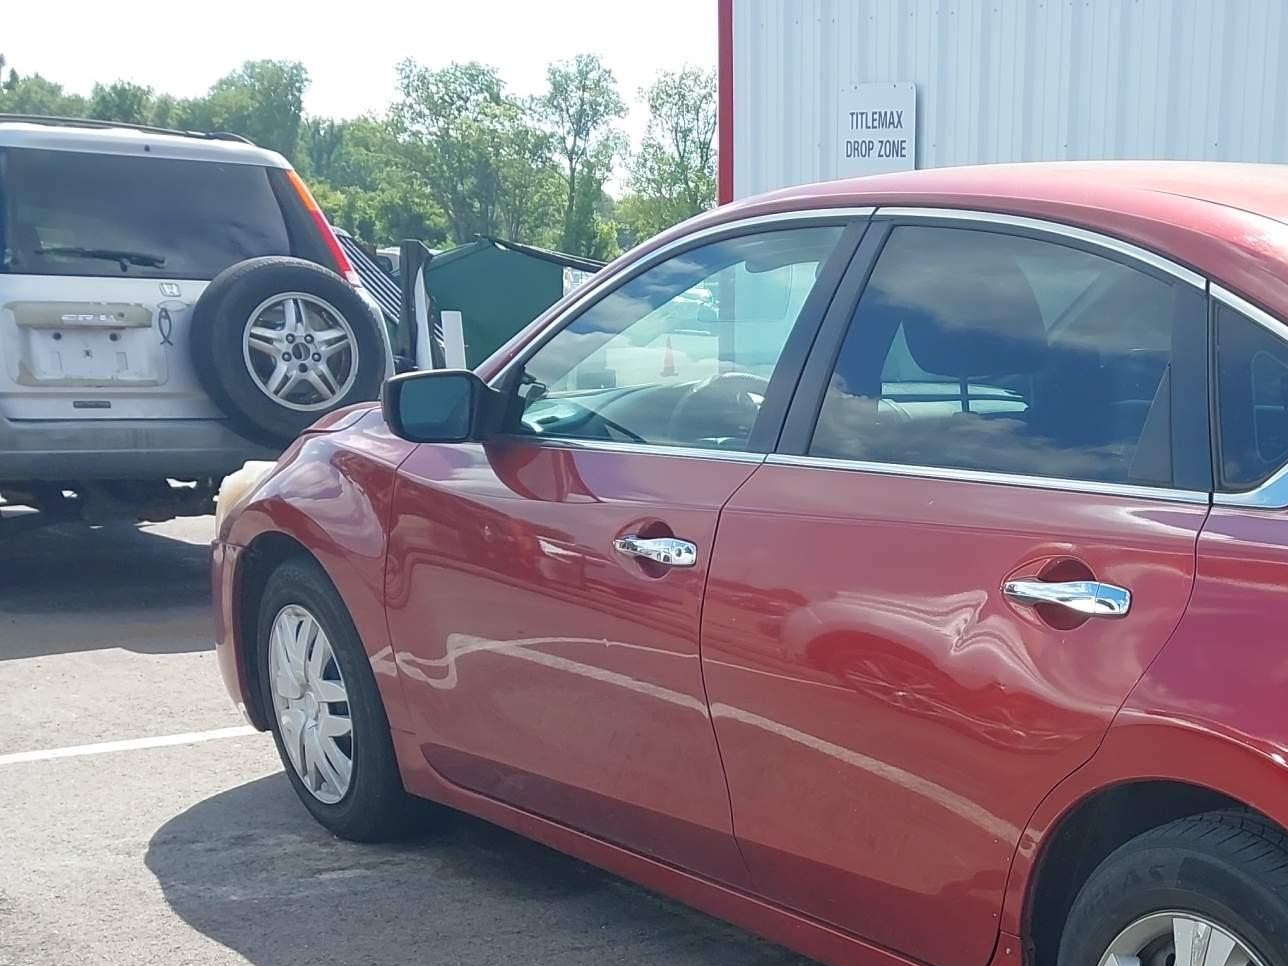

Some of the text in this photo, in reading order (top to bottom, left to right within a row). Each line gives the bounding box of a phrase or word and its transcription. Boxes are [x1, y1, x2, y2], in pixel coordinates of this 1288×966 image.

[849, 110, 903, 130] TITLEMAX
[846, 140, 907, 158] DROP ZONE
